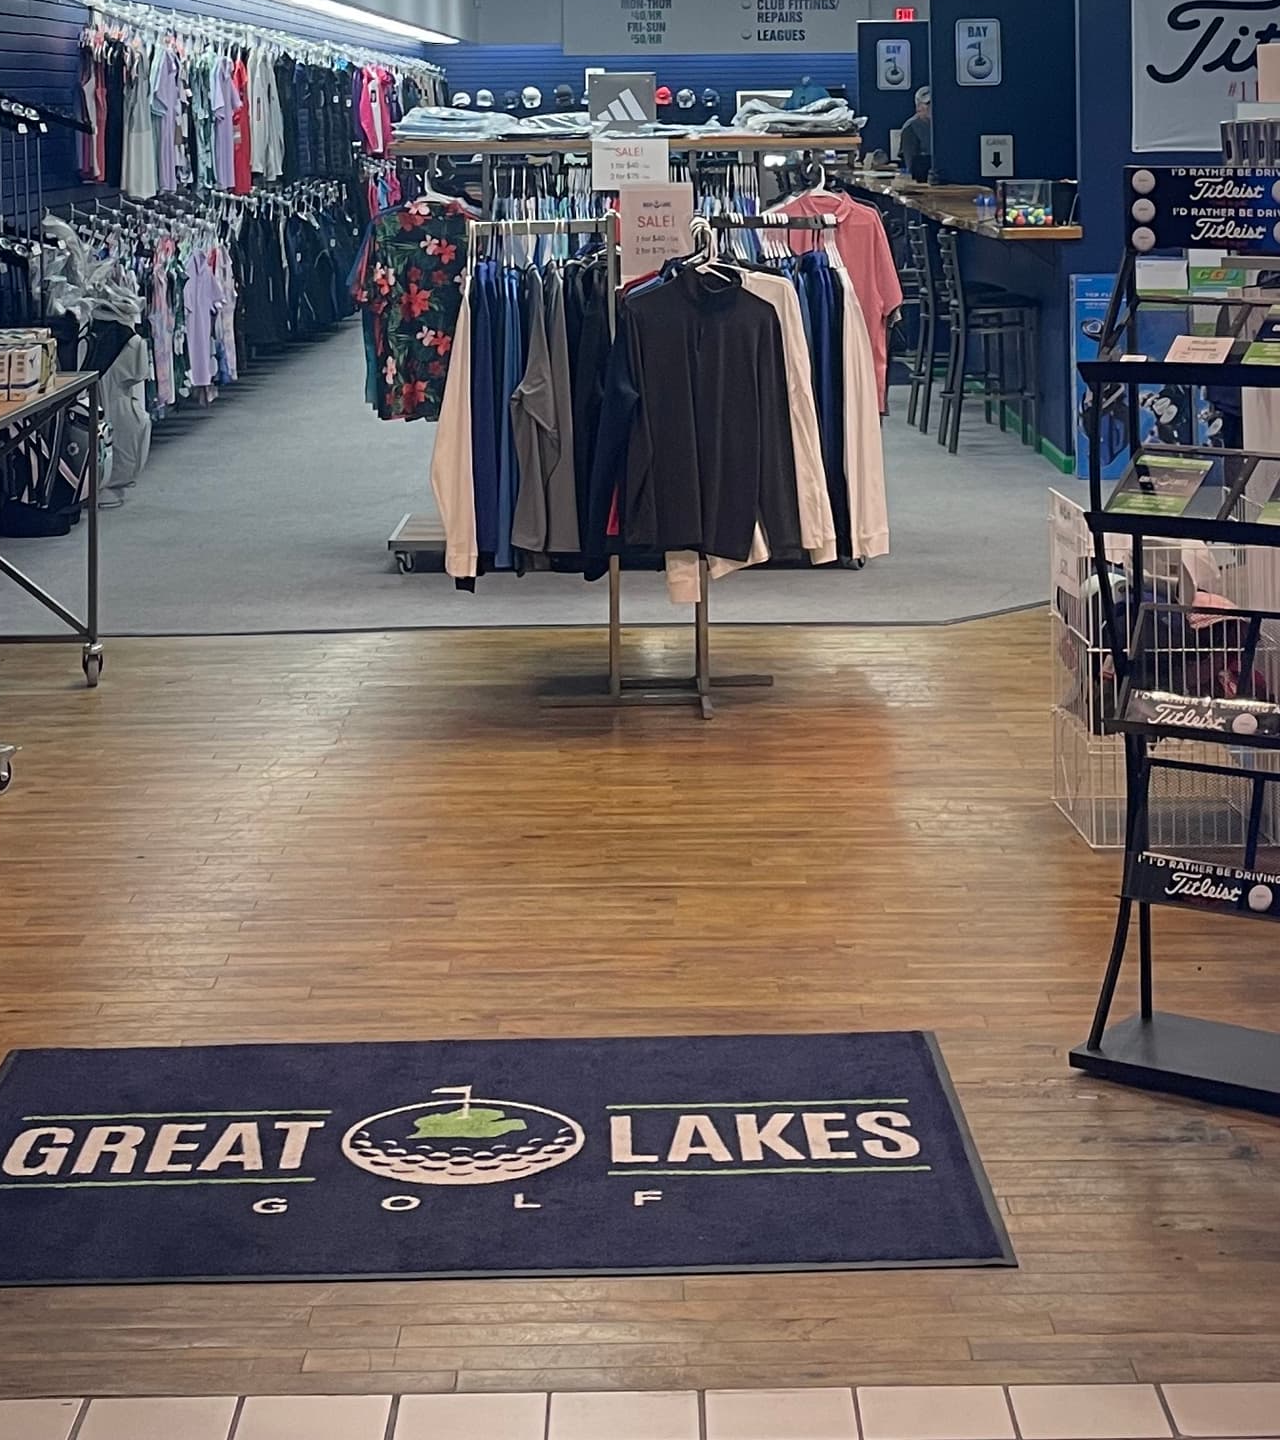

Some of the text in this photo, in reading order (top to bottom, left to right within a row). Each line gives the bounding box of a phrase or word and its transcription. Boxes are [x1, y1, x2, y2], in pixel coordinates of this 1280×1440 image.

[757, 0, 785, 10] CLUB
[757, 11, 803, 23] REPAIRS
[627, 22, 666, 32] FRI-SUN
[967, 26, 988, 38] BAY
[757, 29, 806, 41] LEAGUES
[615, 147, 644, 157] SALE!
[1171, 168, 1186, 176] I'D
[1189, 168, 1234, 177] RATHER
[1237, 168, 1252, 177] BE
[1189, 177, 1265, 200] Titleist
[1172, 207, 1187, 216] I'D
[1191, 207, 1235, 217] RATHER
[1238, 208, 1253, 217] BE
[637, 215, 675, 228] SALE!
[1191, 217, 1267, 241] Titleist
[1147, 703, 1226, 731] Titleist
[1169, 860, 1214, 875] RATHER
[1216, 865, 1231, 878] BE
[1164, 871, 1242, 902] Titleist
[2, 1107, 920, 1180] GREAT LAKES
[252, 1189, 664, 1215] GOLF
